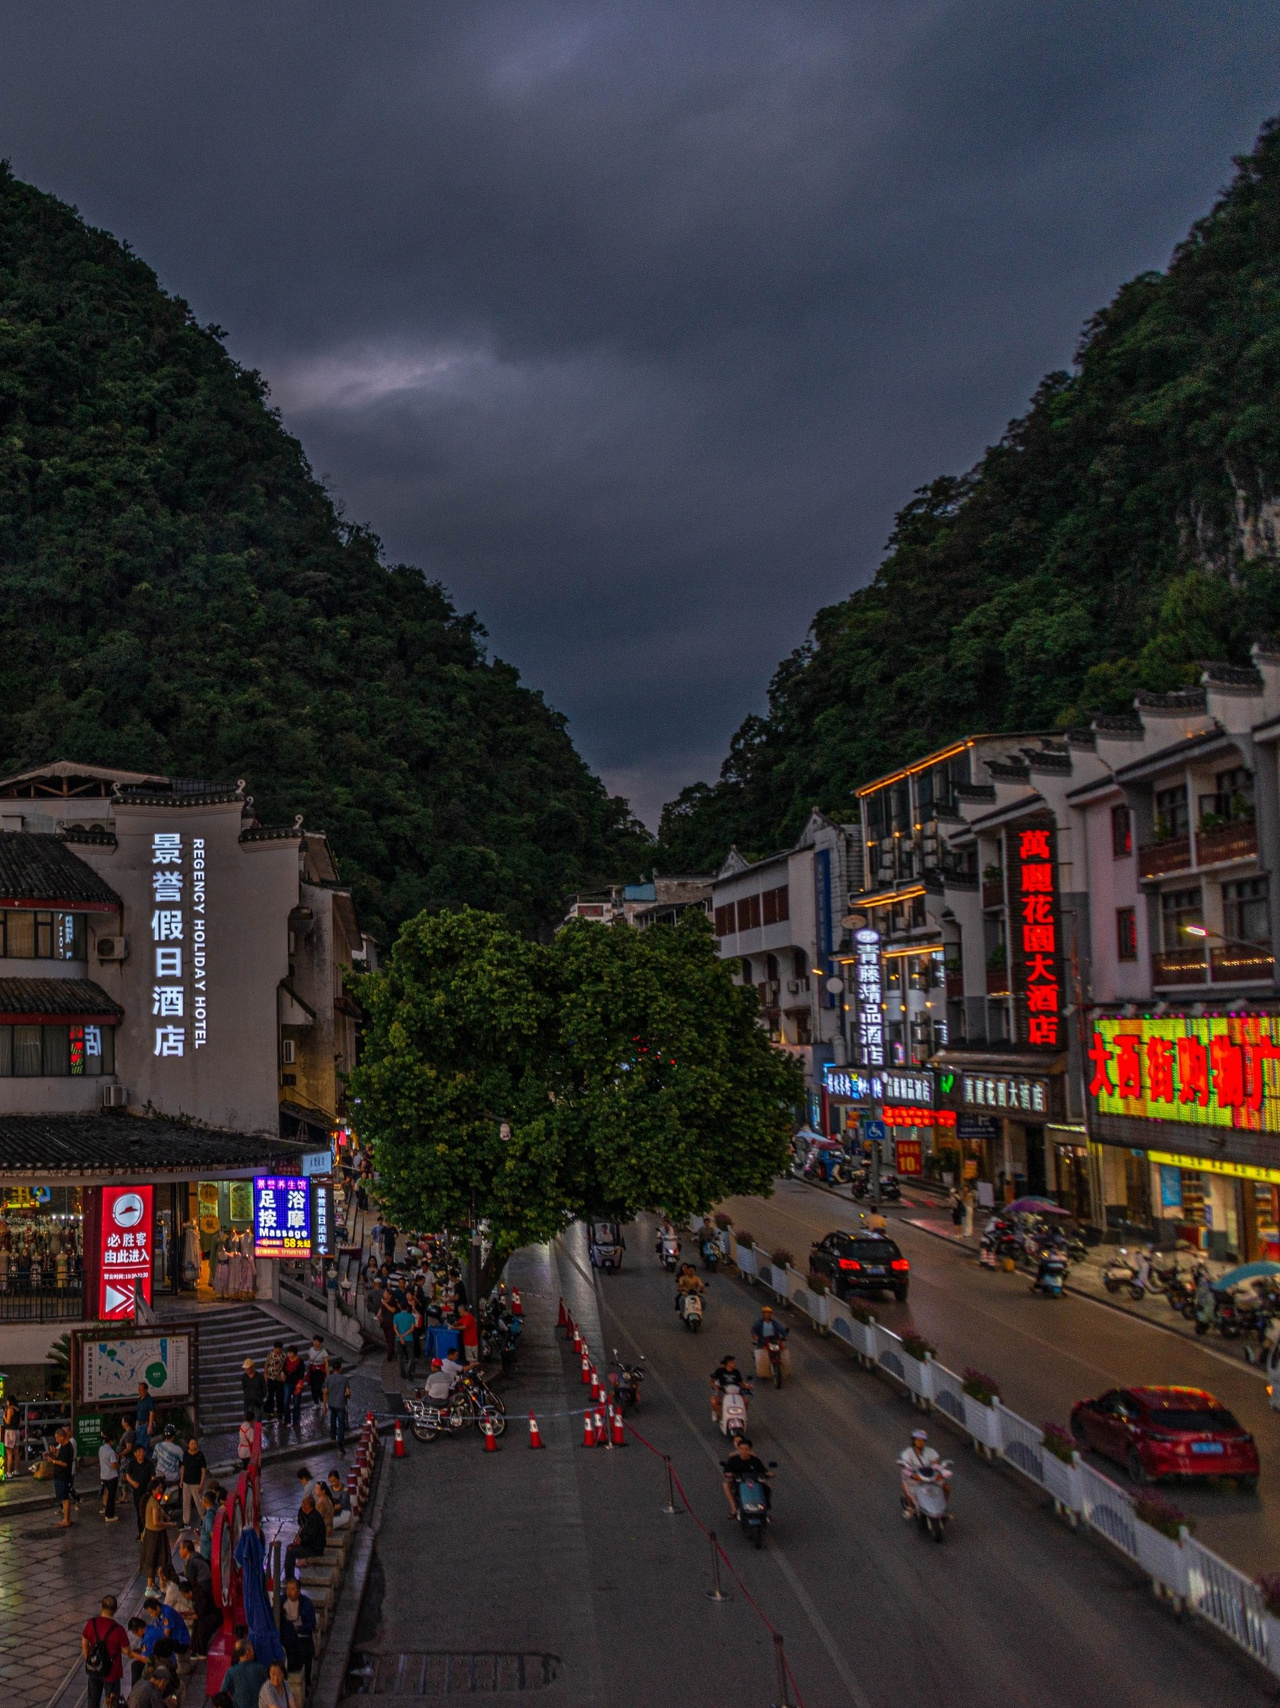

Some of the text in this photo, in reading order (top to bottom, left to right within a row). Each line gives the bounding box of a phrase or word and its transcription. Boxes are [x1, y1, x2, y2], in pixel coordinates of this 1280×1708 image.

[151, 833, 185, 1057] 景誉假日酒店
[193, 838, 207, 1049] REGENCY HOLIDAY HOTEL
[1019, 829, 1060, 1046] 萬麗花園大酒店
[856, 944, 884, 1066] 青藤精品酒店
[104, 1249, 150, 1264] 由此进入
[107, 1232, 147, 1248] 必胜客
[259, 1228, 308, 1239] Massage
